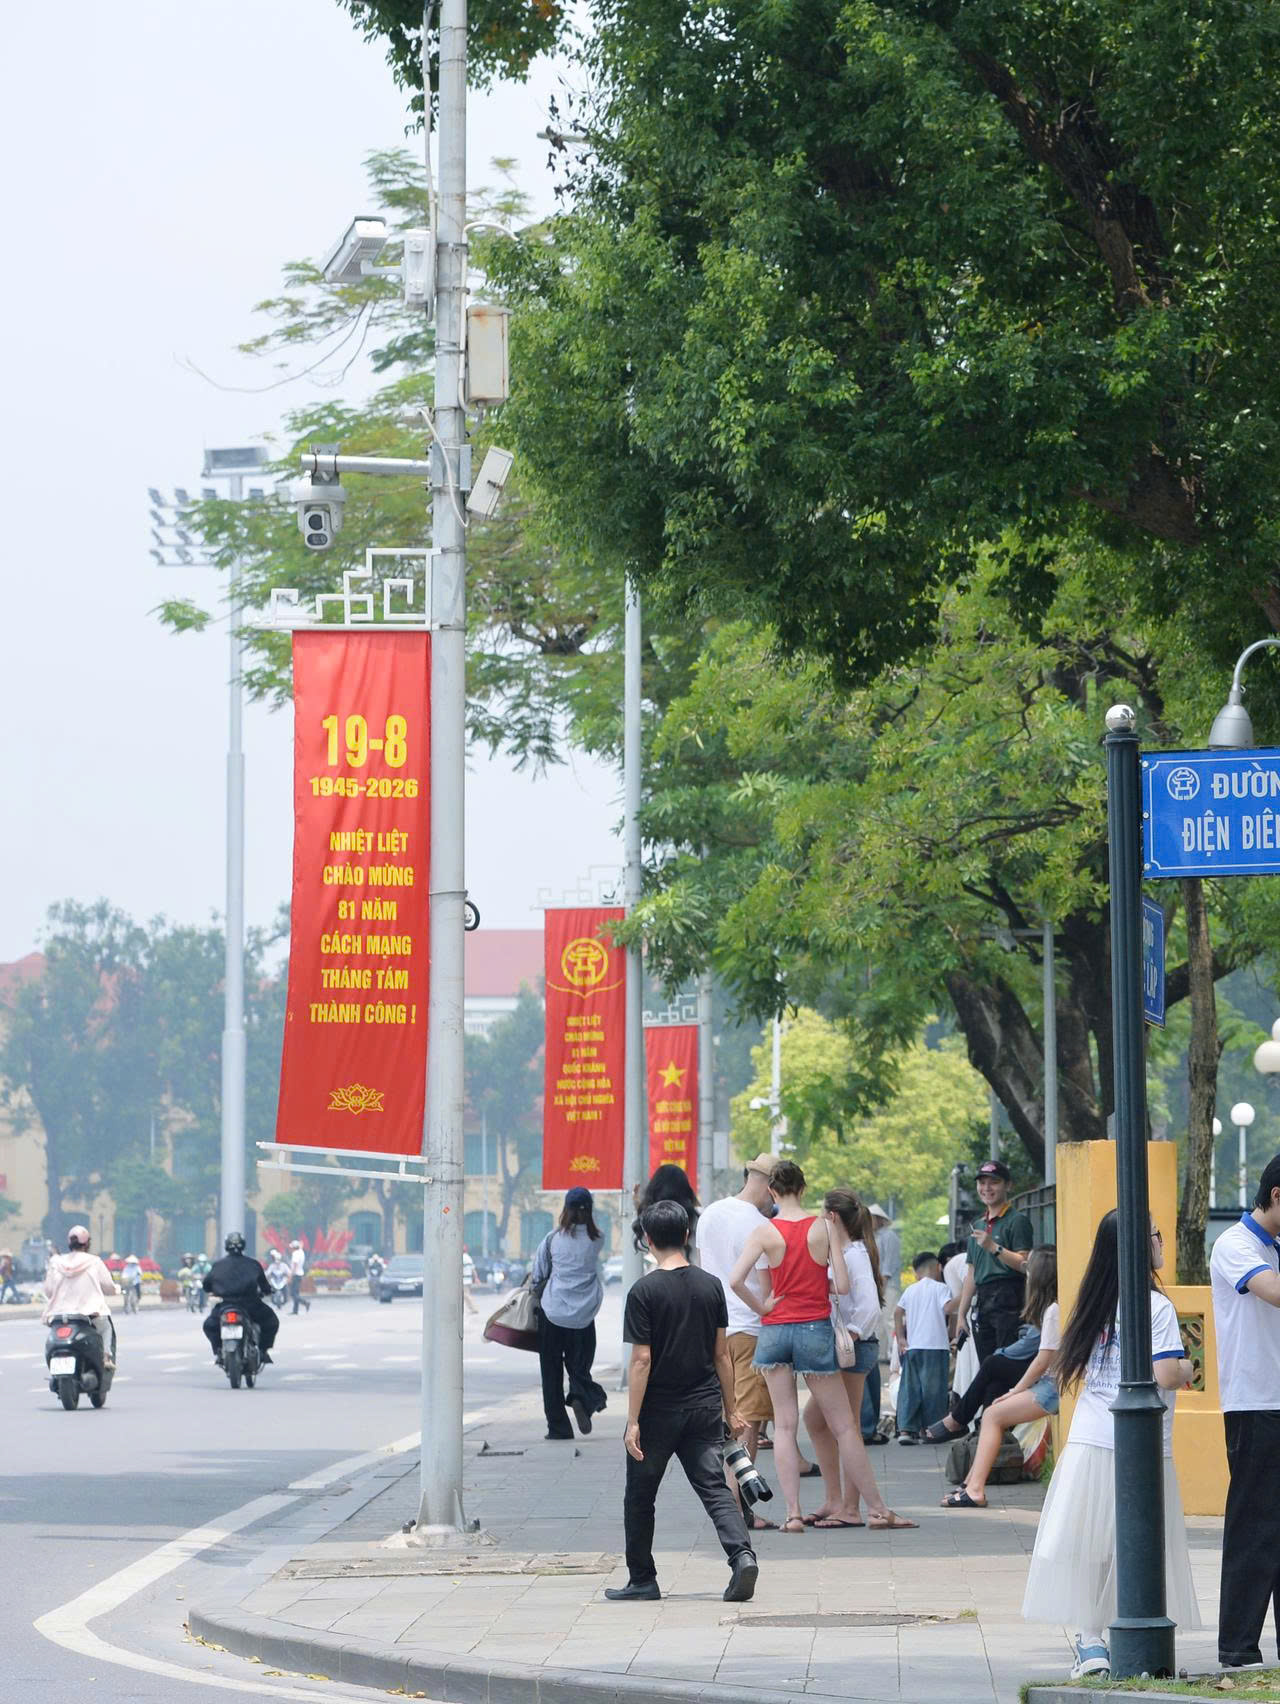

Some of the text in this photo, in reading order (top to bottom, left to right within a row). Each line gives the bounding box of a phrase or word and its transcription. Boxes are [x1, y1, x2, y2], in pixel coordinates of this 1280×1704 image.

[322, 714, 408, 769] 19-8
[310, 776, 419, 799] 1945-2026
[330, 828, 409, 856] NHIỆT LIỆT
[1182, 809, 1230, 856] ĐIỆN
[323, 863, 414, 887] CHÀO MỪNG
[338, 897, 397, 921] 81 NĂM
[320, 930, 412, 958] CÁCH MẠNG
[321, 966, 409, 990] THÁNG TÁM
[310, 999, 361, 1024] THÀNH
[364, 1000, 407, 1025] CÔNG
